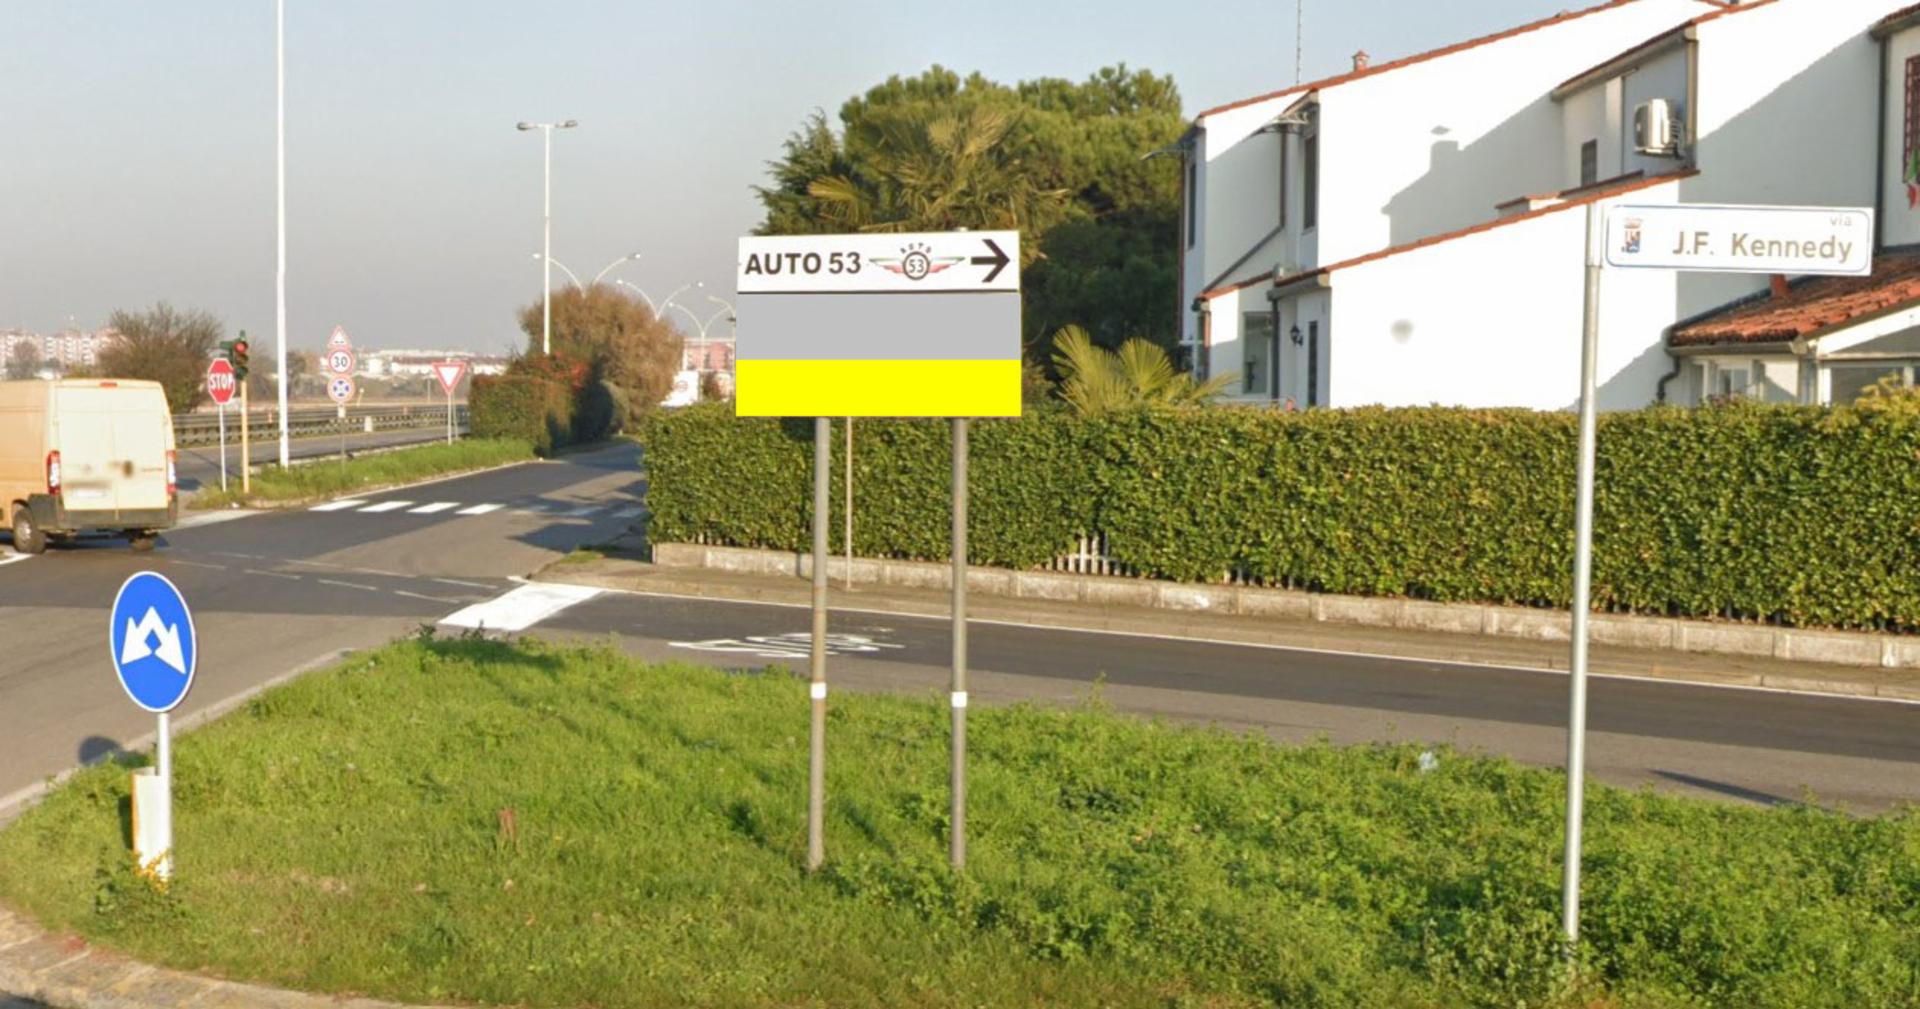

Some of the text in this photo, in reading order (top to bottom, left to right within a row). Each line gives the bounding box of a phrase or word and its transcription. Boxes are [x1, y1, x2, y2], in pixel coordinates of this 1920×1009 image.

[1830, 215, 1853, 227] via
[1672, 231, 1853, 264] J.F. Kennedy
[744, 252, 861, 275] AUTO 53
[908, 258, 924, 273] 53
[333, 356, 348, 368] 30
[209, 373, 235, 390] STOP
